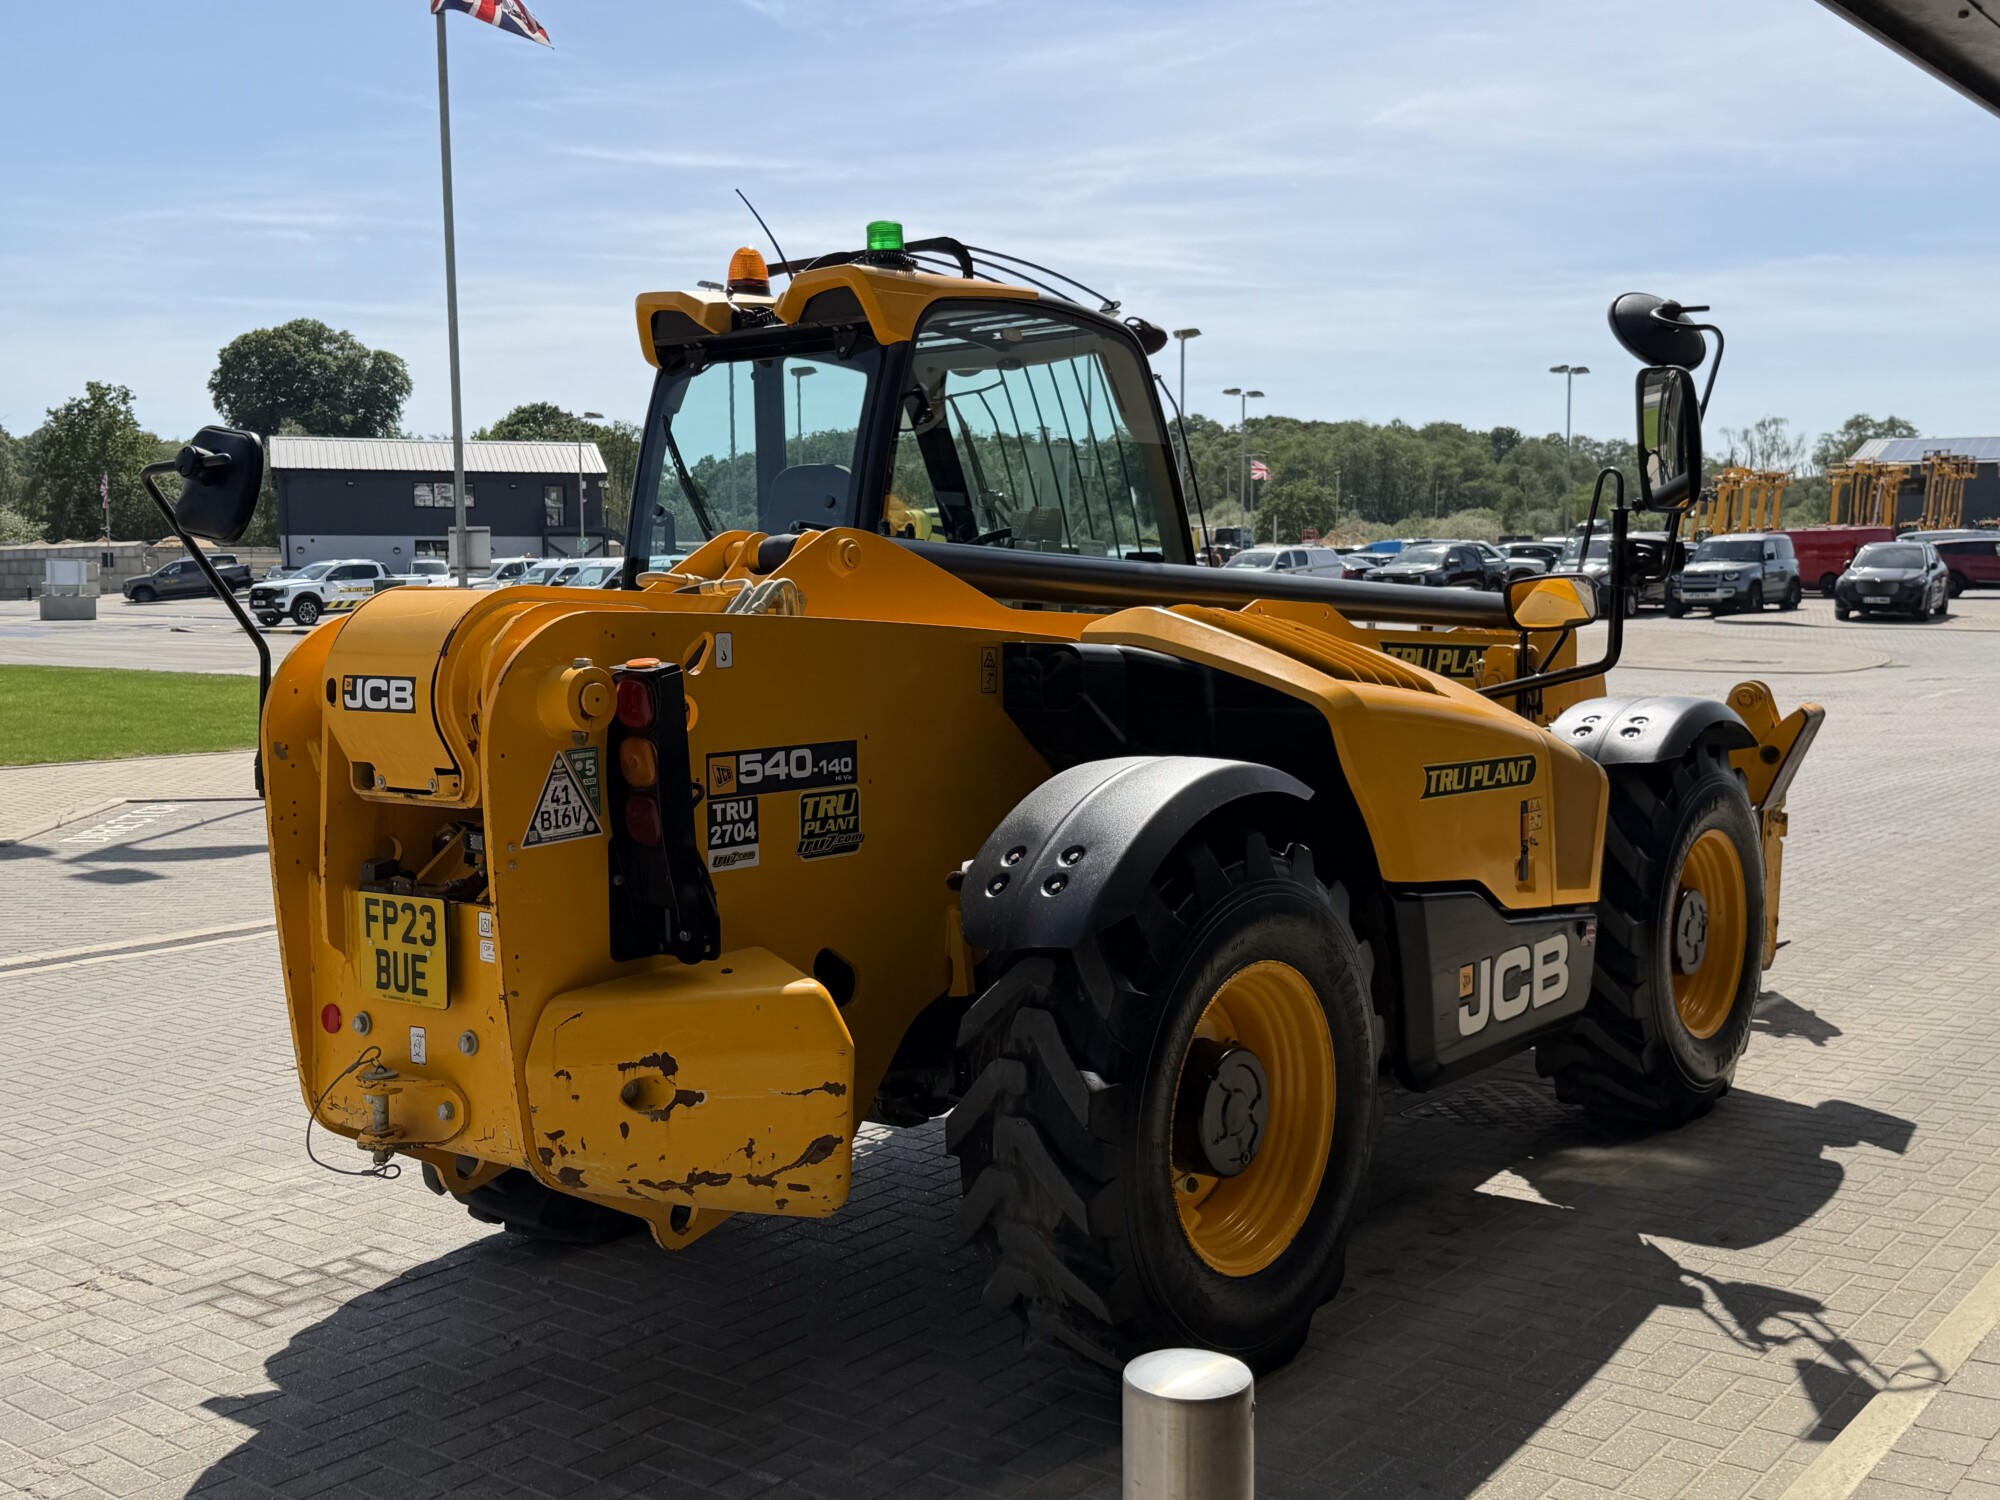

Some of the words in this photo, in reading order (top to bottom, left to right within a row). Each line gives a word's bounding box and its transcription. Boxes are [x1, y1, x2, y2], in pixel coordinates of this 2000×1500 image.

[1435, 648, 1488, 674] PLA
[344, 678, 413, 710] JCB
[585, 759, 596, 776] 5
[714, 765, 734, 787] JCB
[739, 748, 853, 785] 540-140
[1428, 766, 1468, 794] TRU
[1469, 760, 1532, 788] PLANT
[551, 784, 572, 806] 41
[802, 792, 857, 820] TRU
[712, 799, 753, 823] TRU
[710, 820, 757, 845] 2704
[803, 815, 858, 836] PLANT
[364, 897, 437, 947] FP23
[375, 948, 429, 998] BUE
[1458, 933, 1569, 1037] JCB
